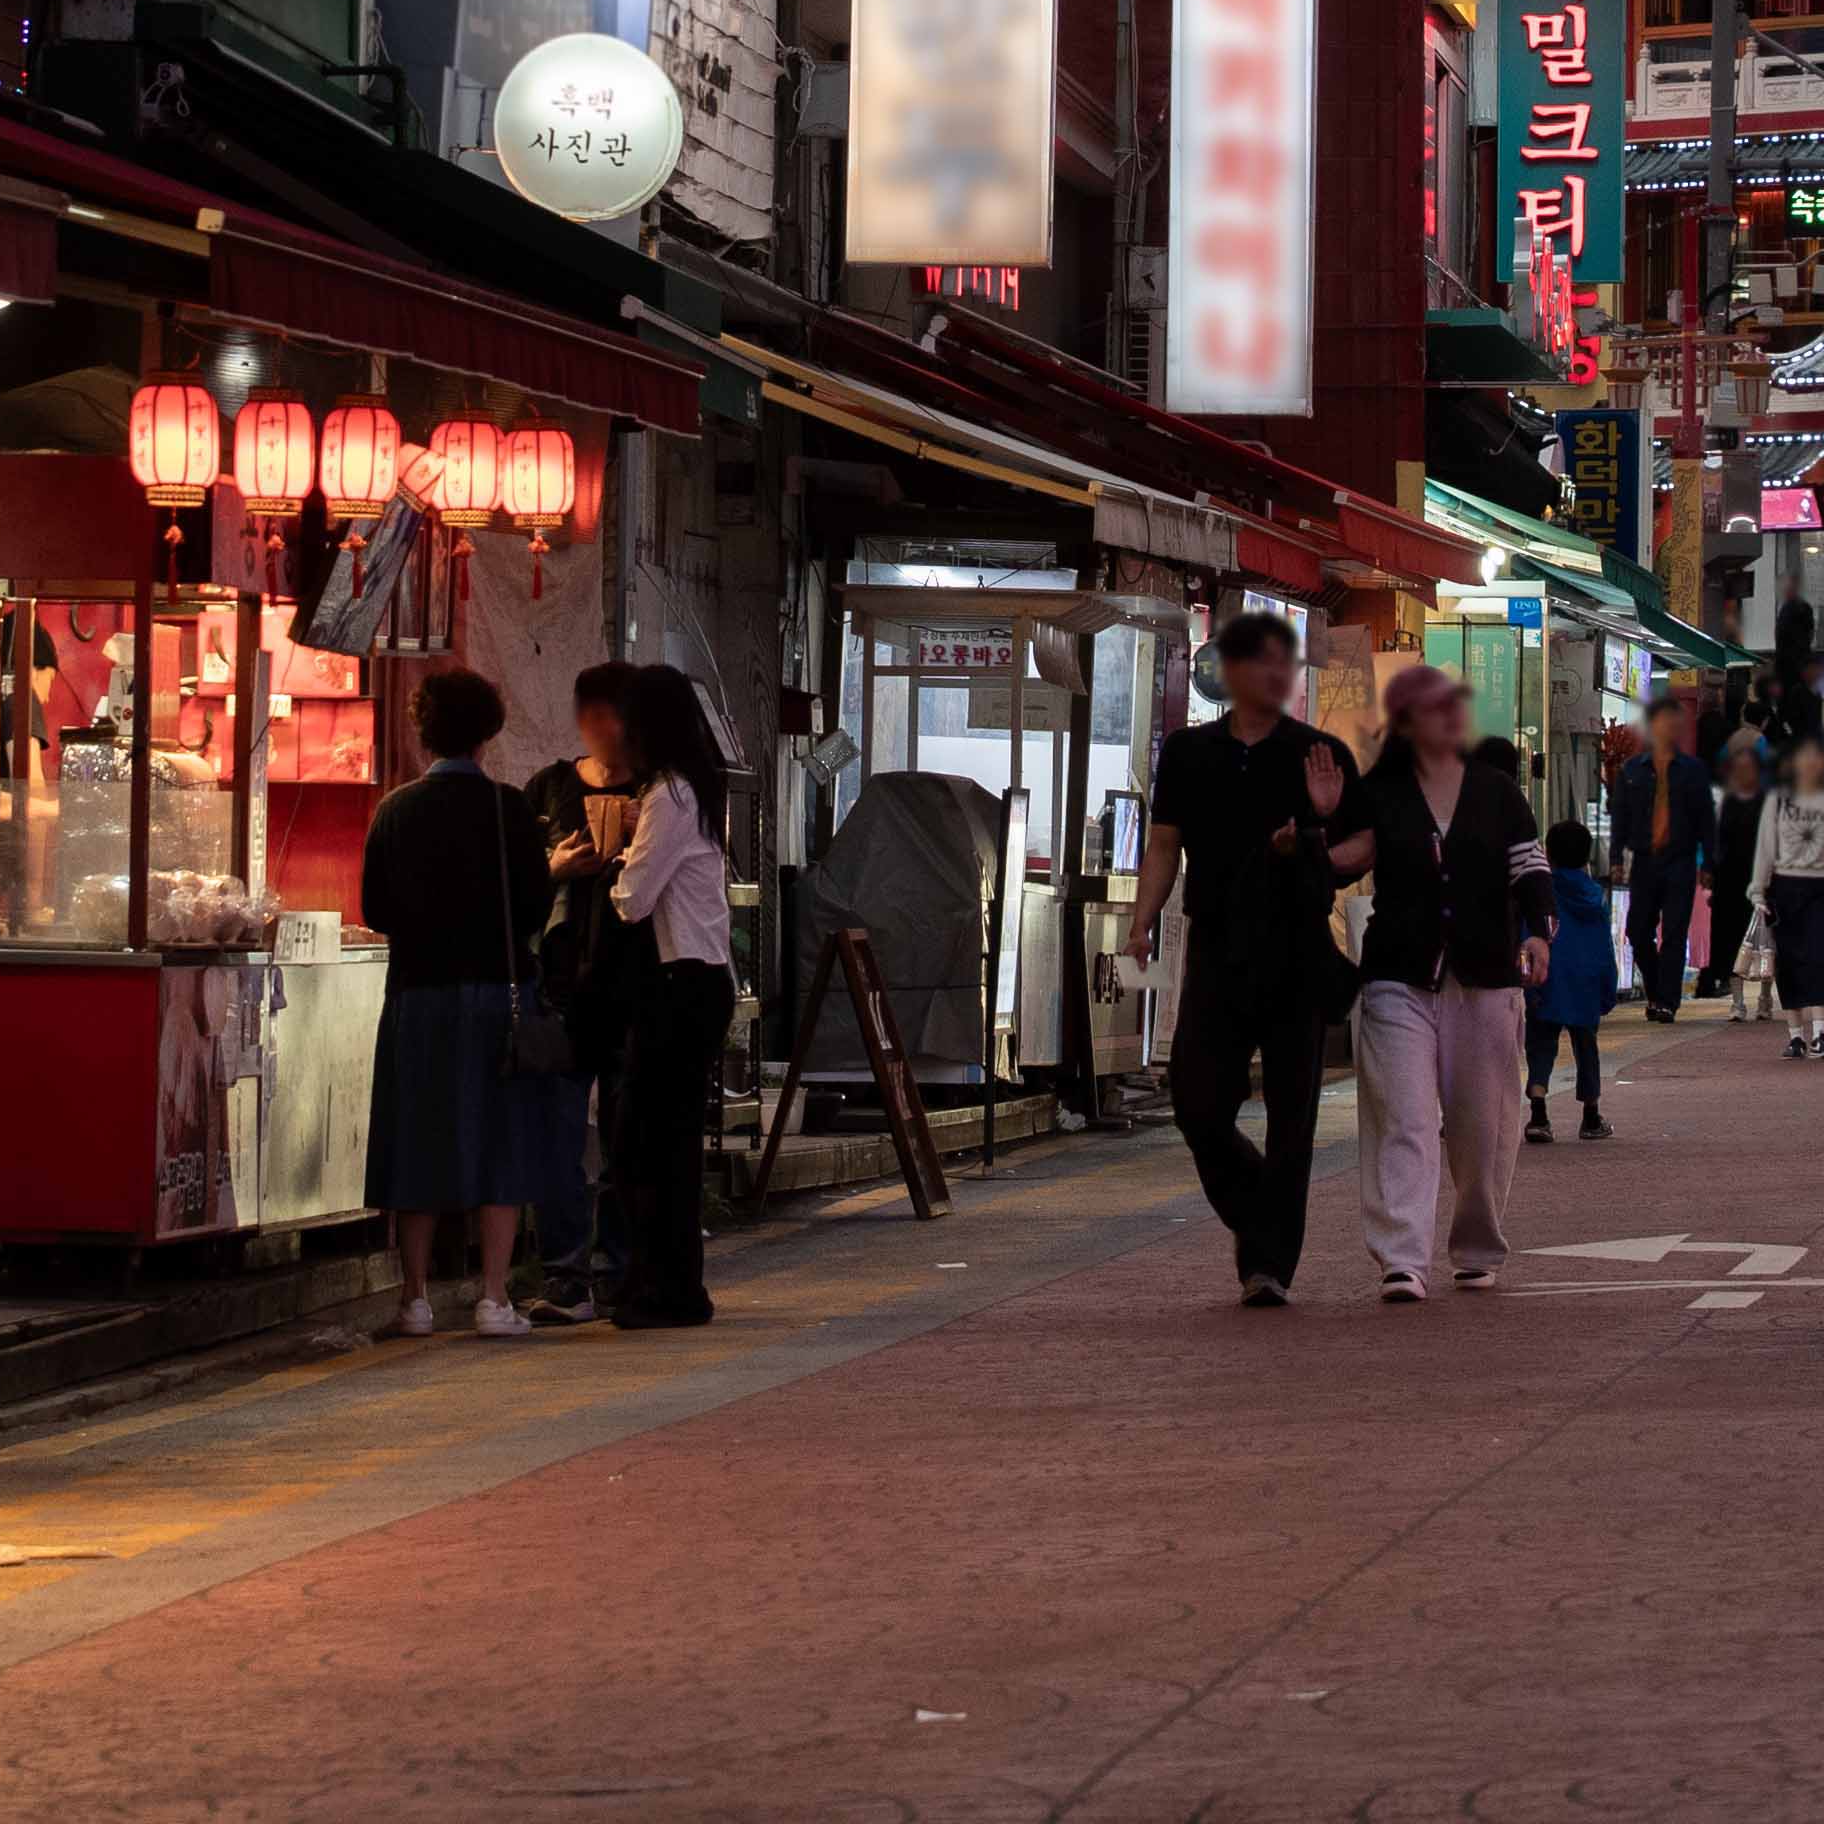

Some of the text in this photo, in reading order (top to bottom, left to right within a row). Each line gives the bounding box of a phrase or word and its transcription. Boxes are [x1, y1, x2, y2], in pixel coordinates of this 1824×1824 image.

[551, 84, 614, 118] 흑백
[527, 127, 632, 167] 사진관
[1573, 419, 1622, 545] 화덕만
